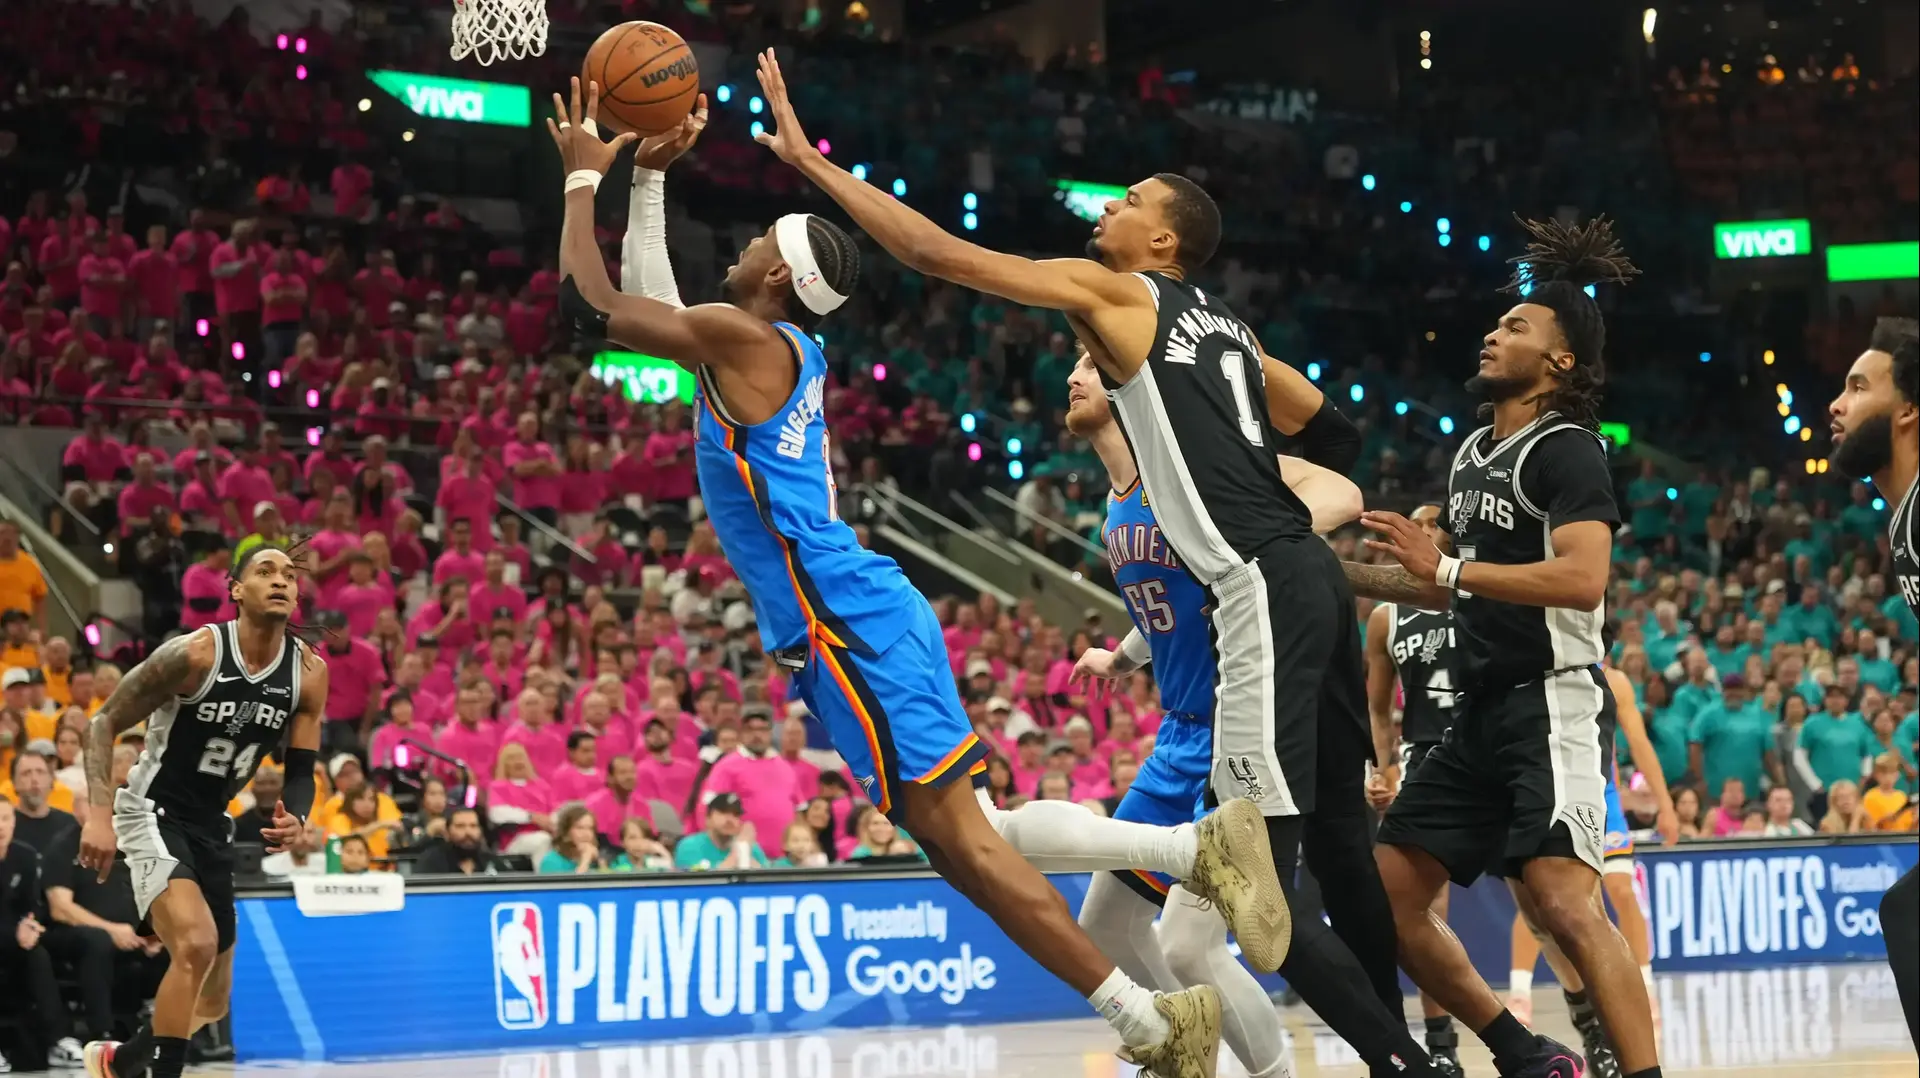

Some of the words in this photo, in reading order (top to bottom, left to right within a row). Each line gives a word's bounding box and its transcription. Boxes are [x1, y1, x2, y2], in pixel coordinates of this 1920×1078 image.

[641, 53, 698, 88] Wilson
[1164, 307, 1266, 388] WEMBANYA
[1219, 350, 1265, 449] 1
[1120, 578, 1176, 635] 55
[1424, 668, 1455, 709] 4
[196, 701, 288, 734] SPURS
[197, 736, 262, 780] 24
[1655, 854, 1828, 960] PLAYOFFS
[1834, 895, 1884, 938] Go
[556, 894, 831, 1025] PLAYOFFS
[845, 942, 997, 1005] Google
